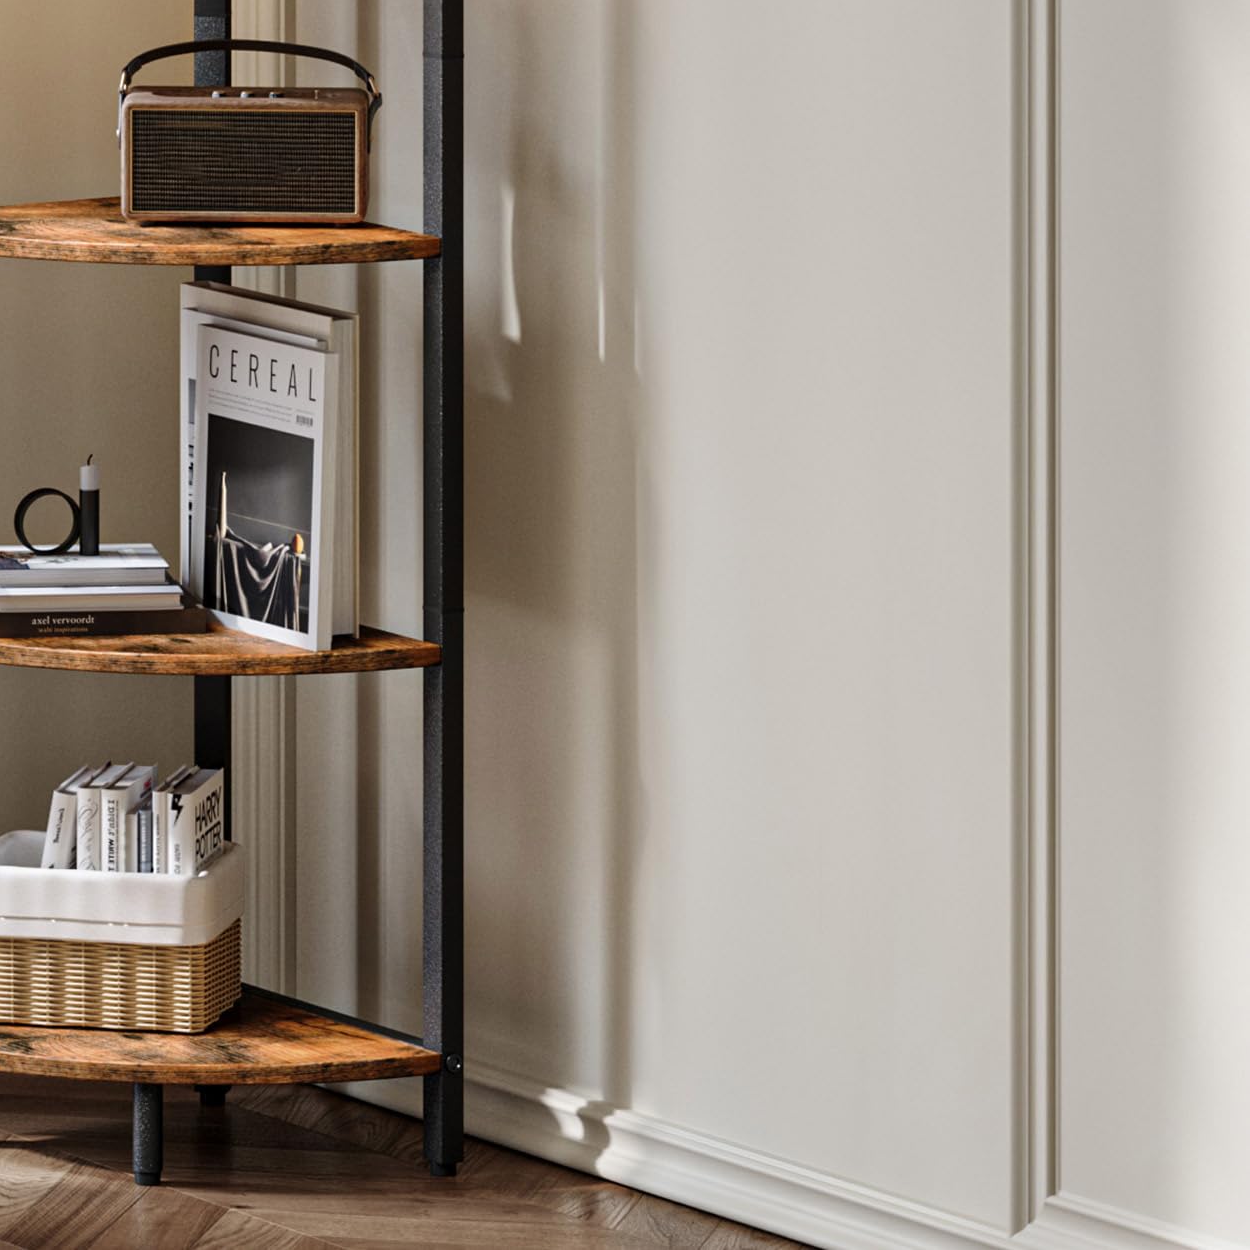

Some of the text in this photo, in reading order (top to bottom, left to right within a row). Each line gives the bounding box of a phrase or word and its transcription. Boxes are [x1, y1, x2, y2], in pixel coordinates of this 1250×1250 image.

[209, 344, 316, 402] CEREAL
[31, 614, 95, 625] axel vervoordt
[195, 786, 222, 835] HARRY
[195, 820, 222, 862] POTTER
